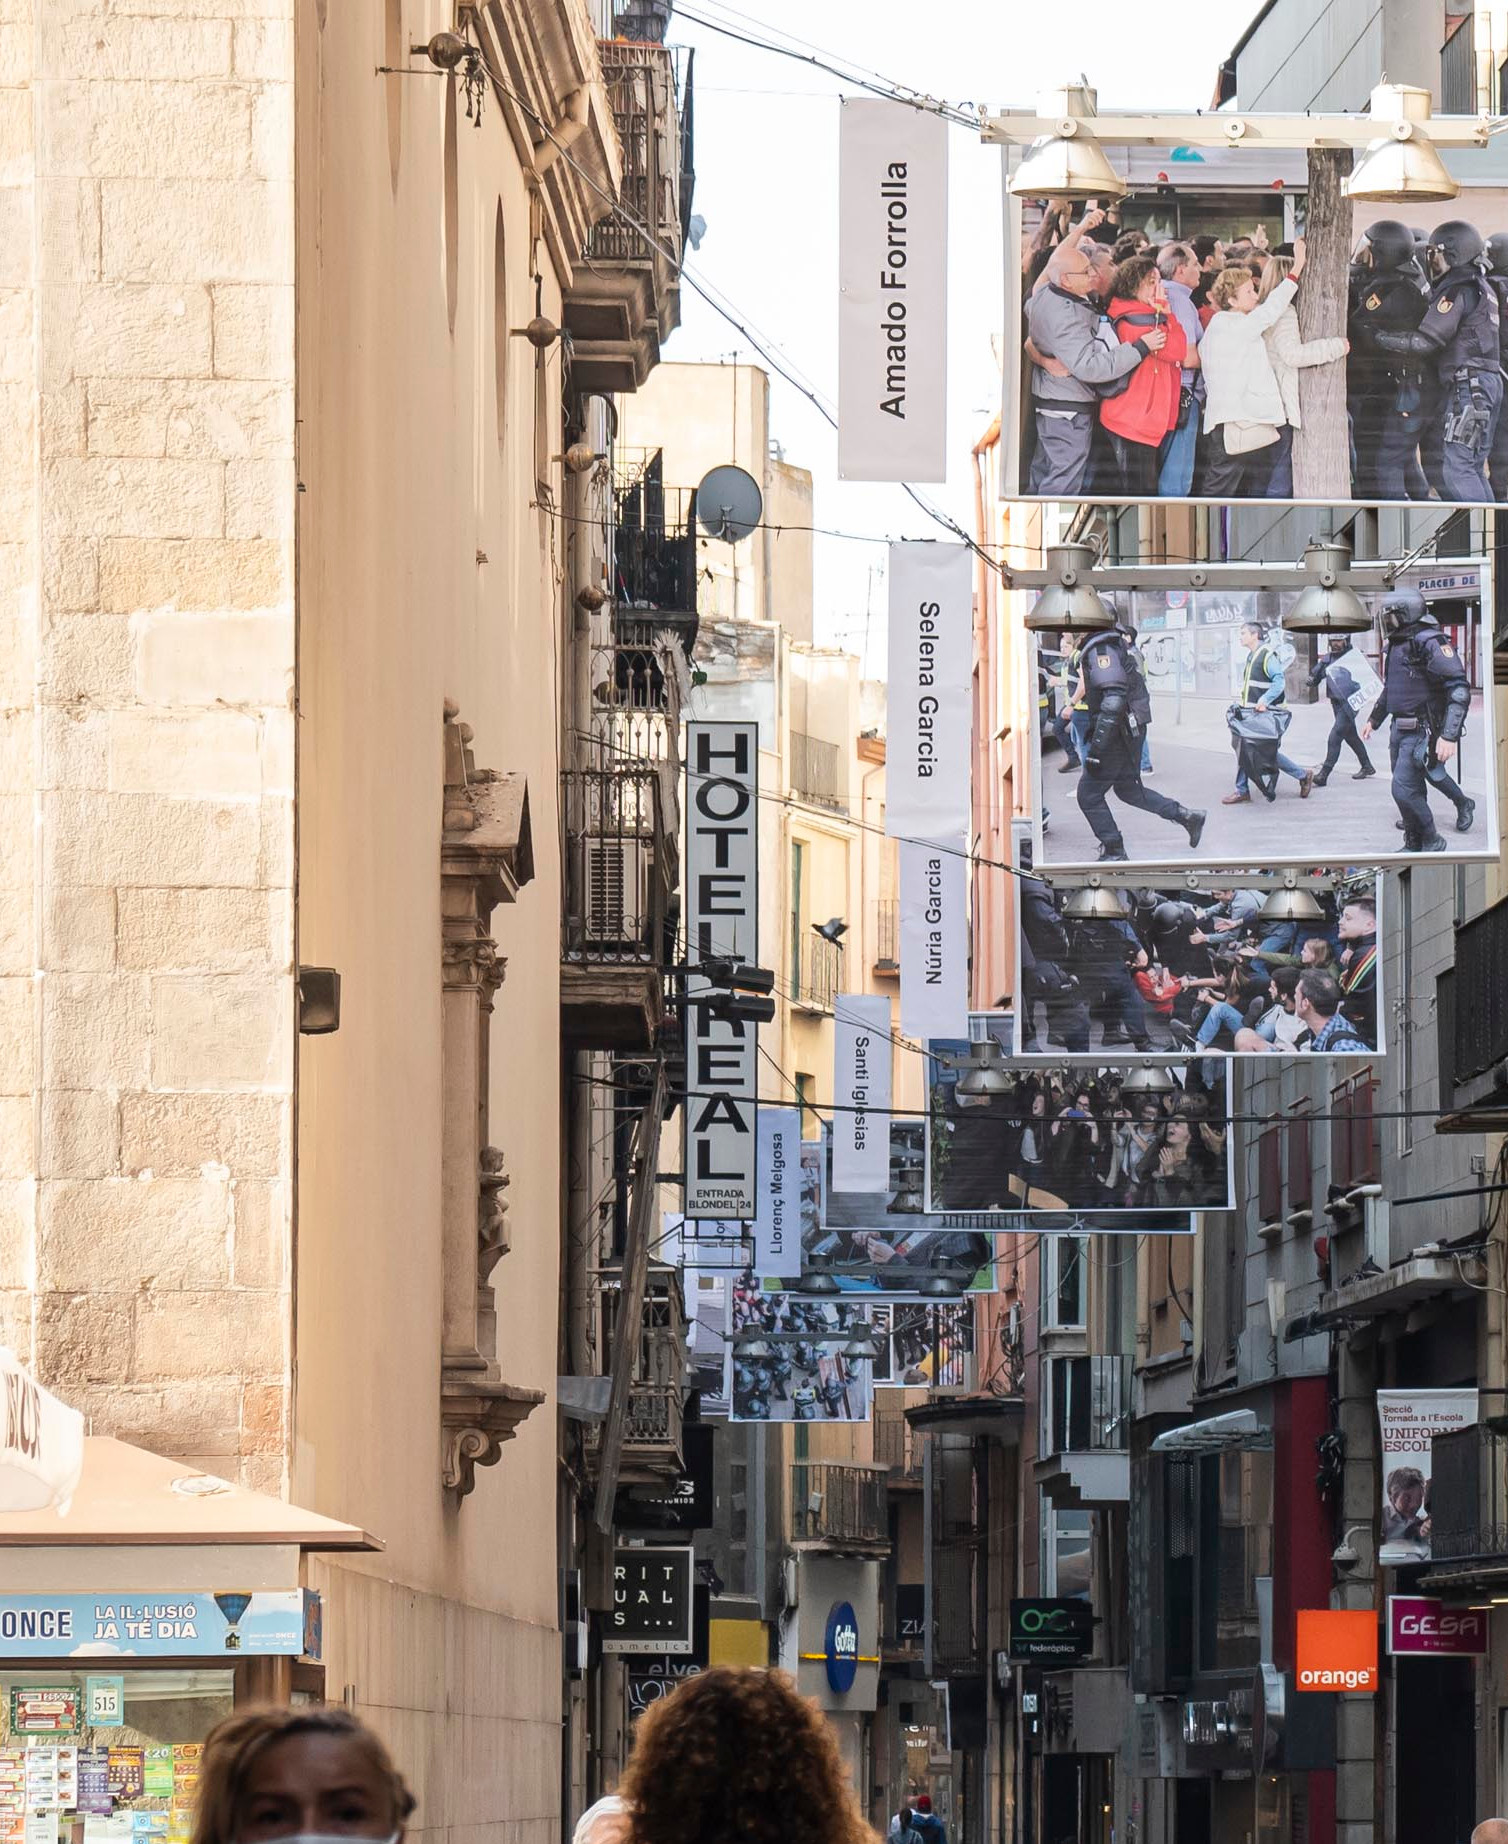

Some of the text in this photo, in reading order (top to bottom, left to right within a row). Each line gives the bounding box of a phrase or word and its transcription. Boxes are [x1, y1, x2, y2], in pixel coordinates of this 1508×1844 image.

[880, 161, 907, 419] Amado Forrolla
[1418, 575, 1476, 590] PLACES DE
[917, 601, 940, 777] Selena Garcia
[695, 732, 749, 963] HOTEL
[924, 858, 942, 985] Núria Garcia
[692, 1000, 749, 1181] REAL
[851, 1036, 870, 1151] Santi Iglesias
[696, 1189, 744, 1198] ENTRADA
[770, 1133, 786, 1254] Llorenç Melgosa
[688, 1200, 752, 1209] BLONDEL 24
[1382, 1405, 1413, 1414] Secció
[1382, 1414, 1419, 1422] Tornada
[1428, 1413, 1464, 1422] l'Escola
[94, 1603, 197, 1620] LA IL·LUSIÓ
[2, 1610, 72, 1640] ONCE
[93, 1620, 198, 1639] JA TÉ DIA
[1400, 1615, 1479, 1636] GESA
[1300, 1667, 1370, 1689] orange
[94, 1696, 116, 1711] 515
